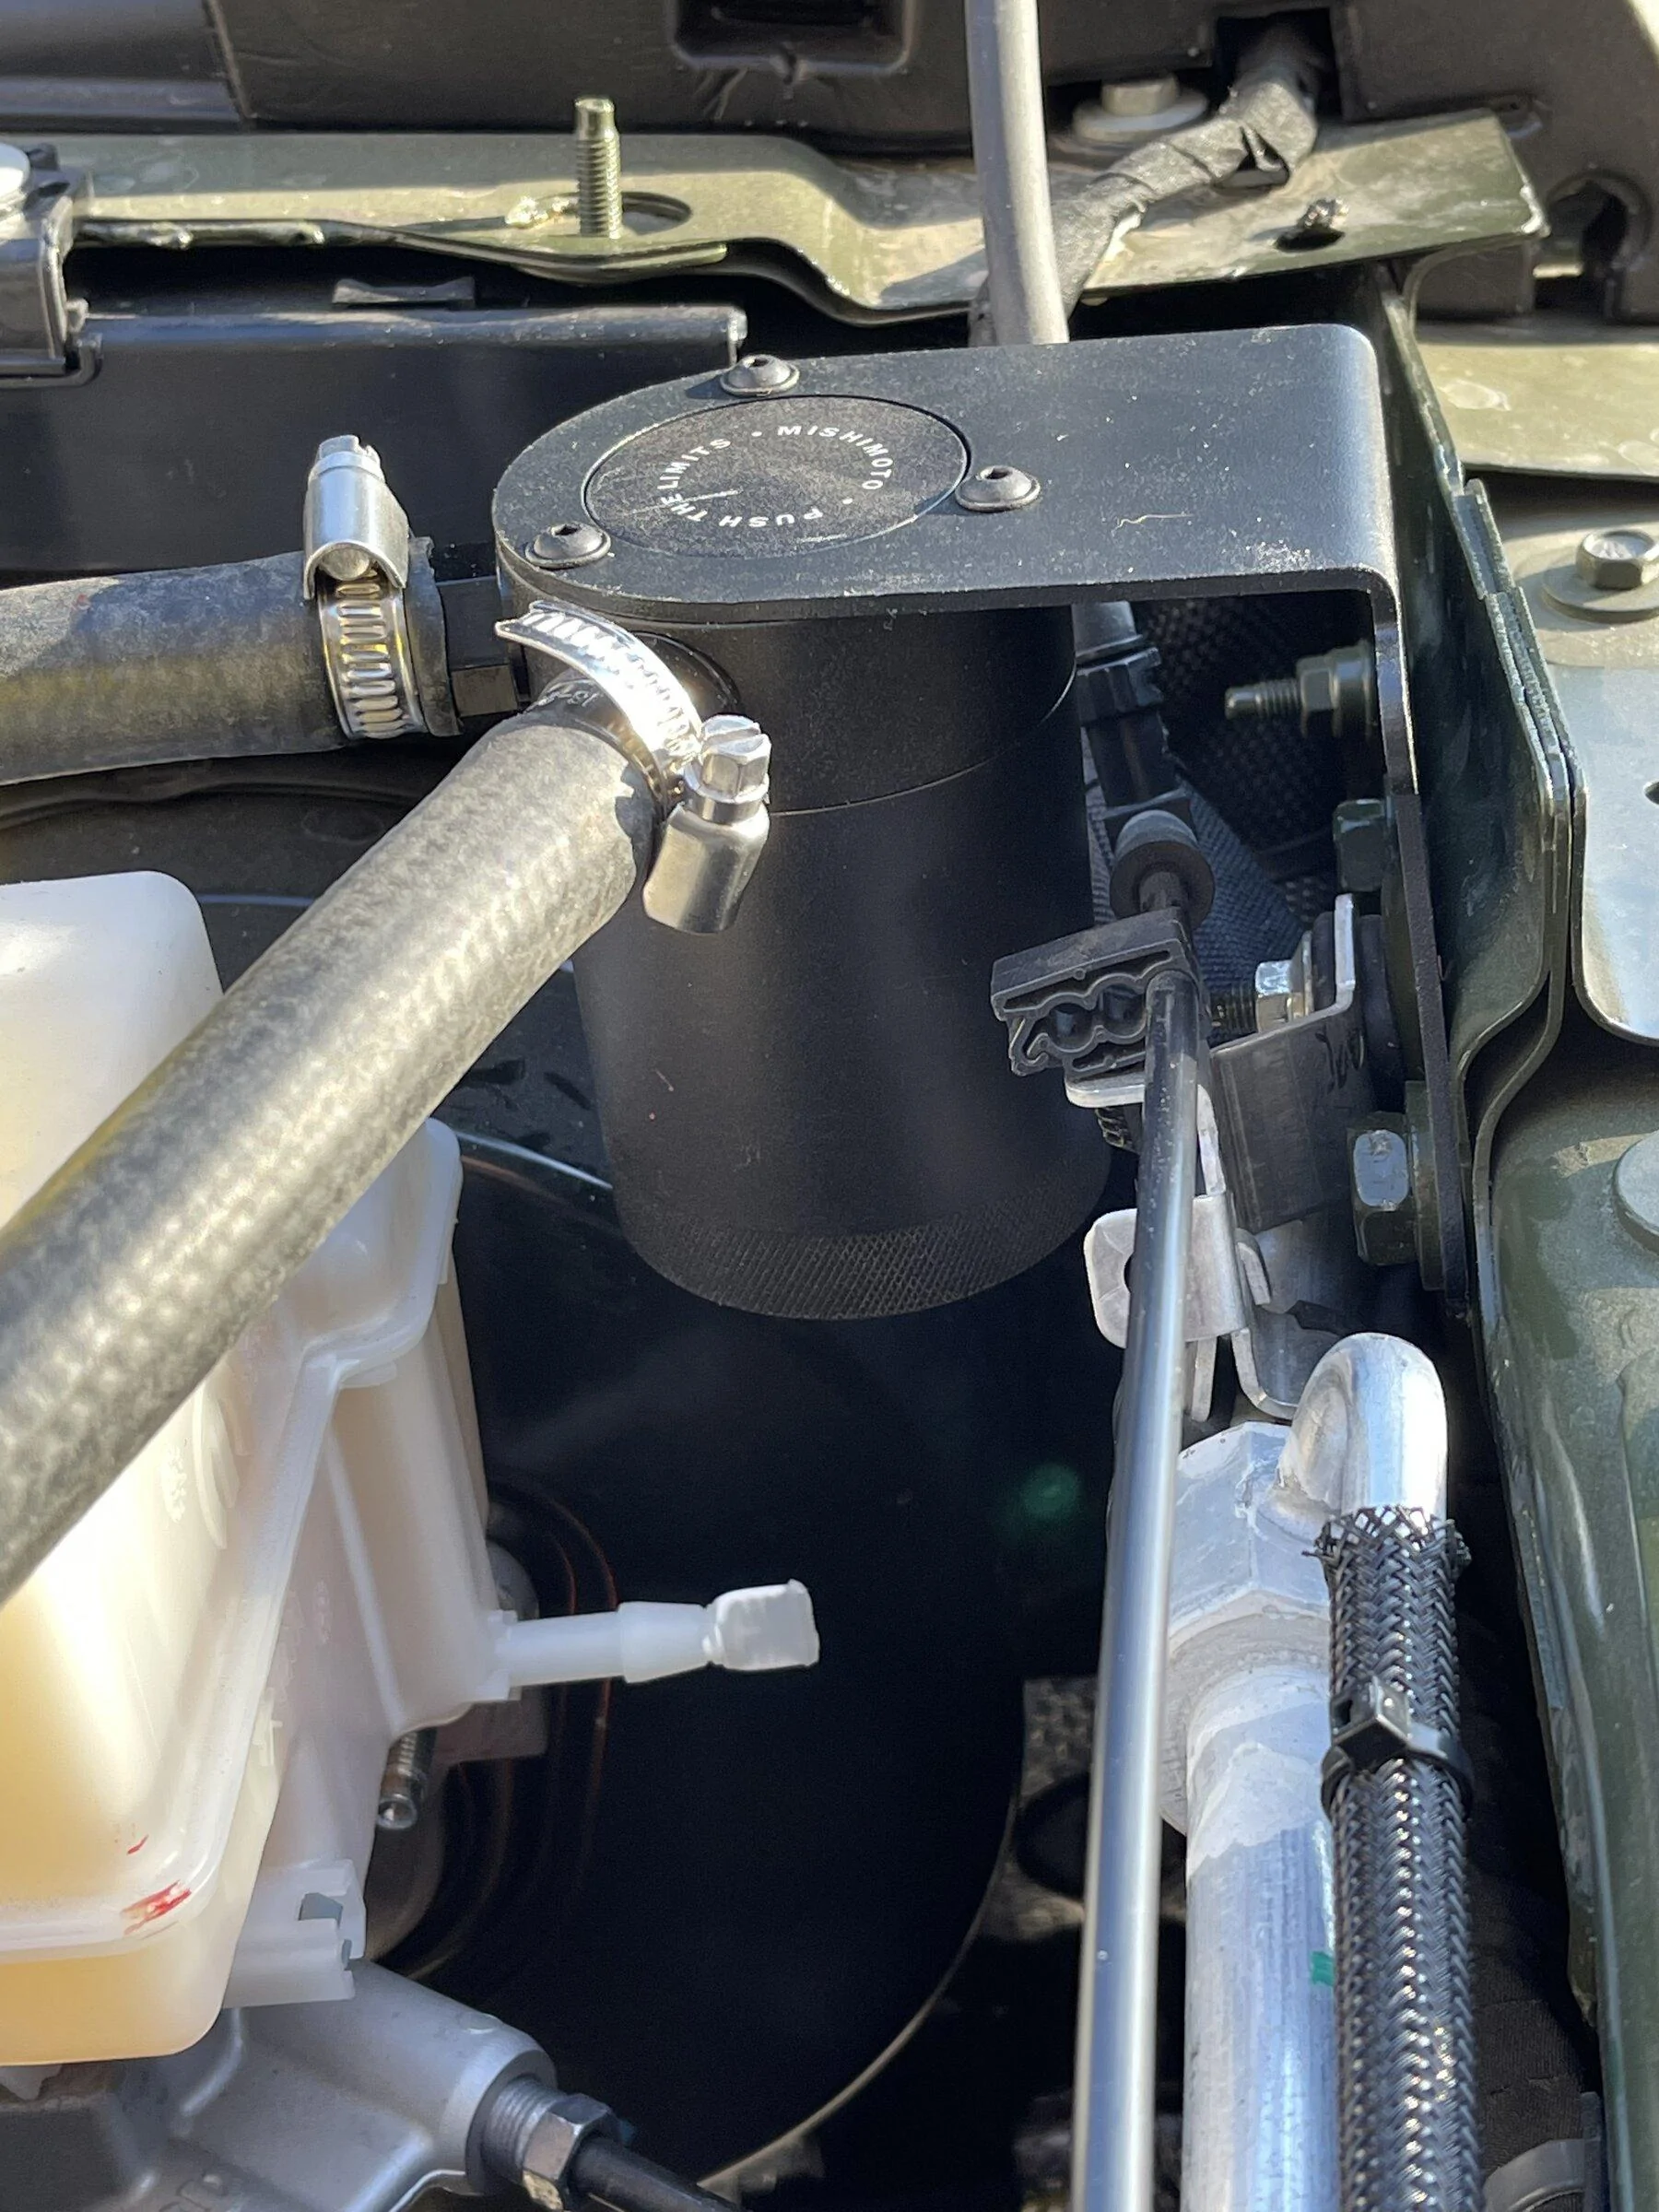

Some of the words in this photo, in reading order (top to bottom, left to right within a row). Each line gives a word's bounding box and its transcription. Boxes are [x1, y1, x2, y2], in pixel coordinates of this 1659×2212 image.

[657, 438, 731, 489] LIMITS
[777, 425, 893, 490] MISHIMOTO
[660, 493, 708, 522] THE
[718, 507, 823, 527] PUSH
